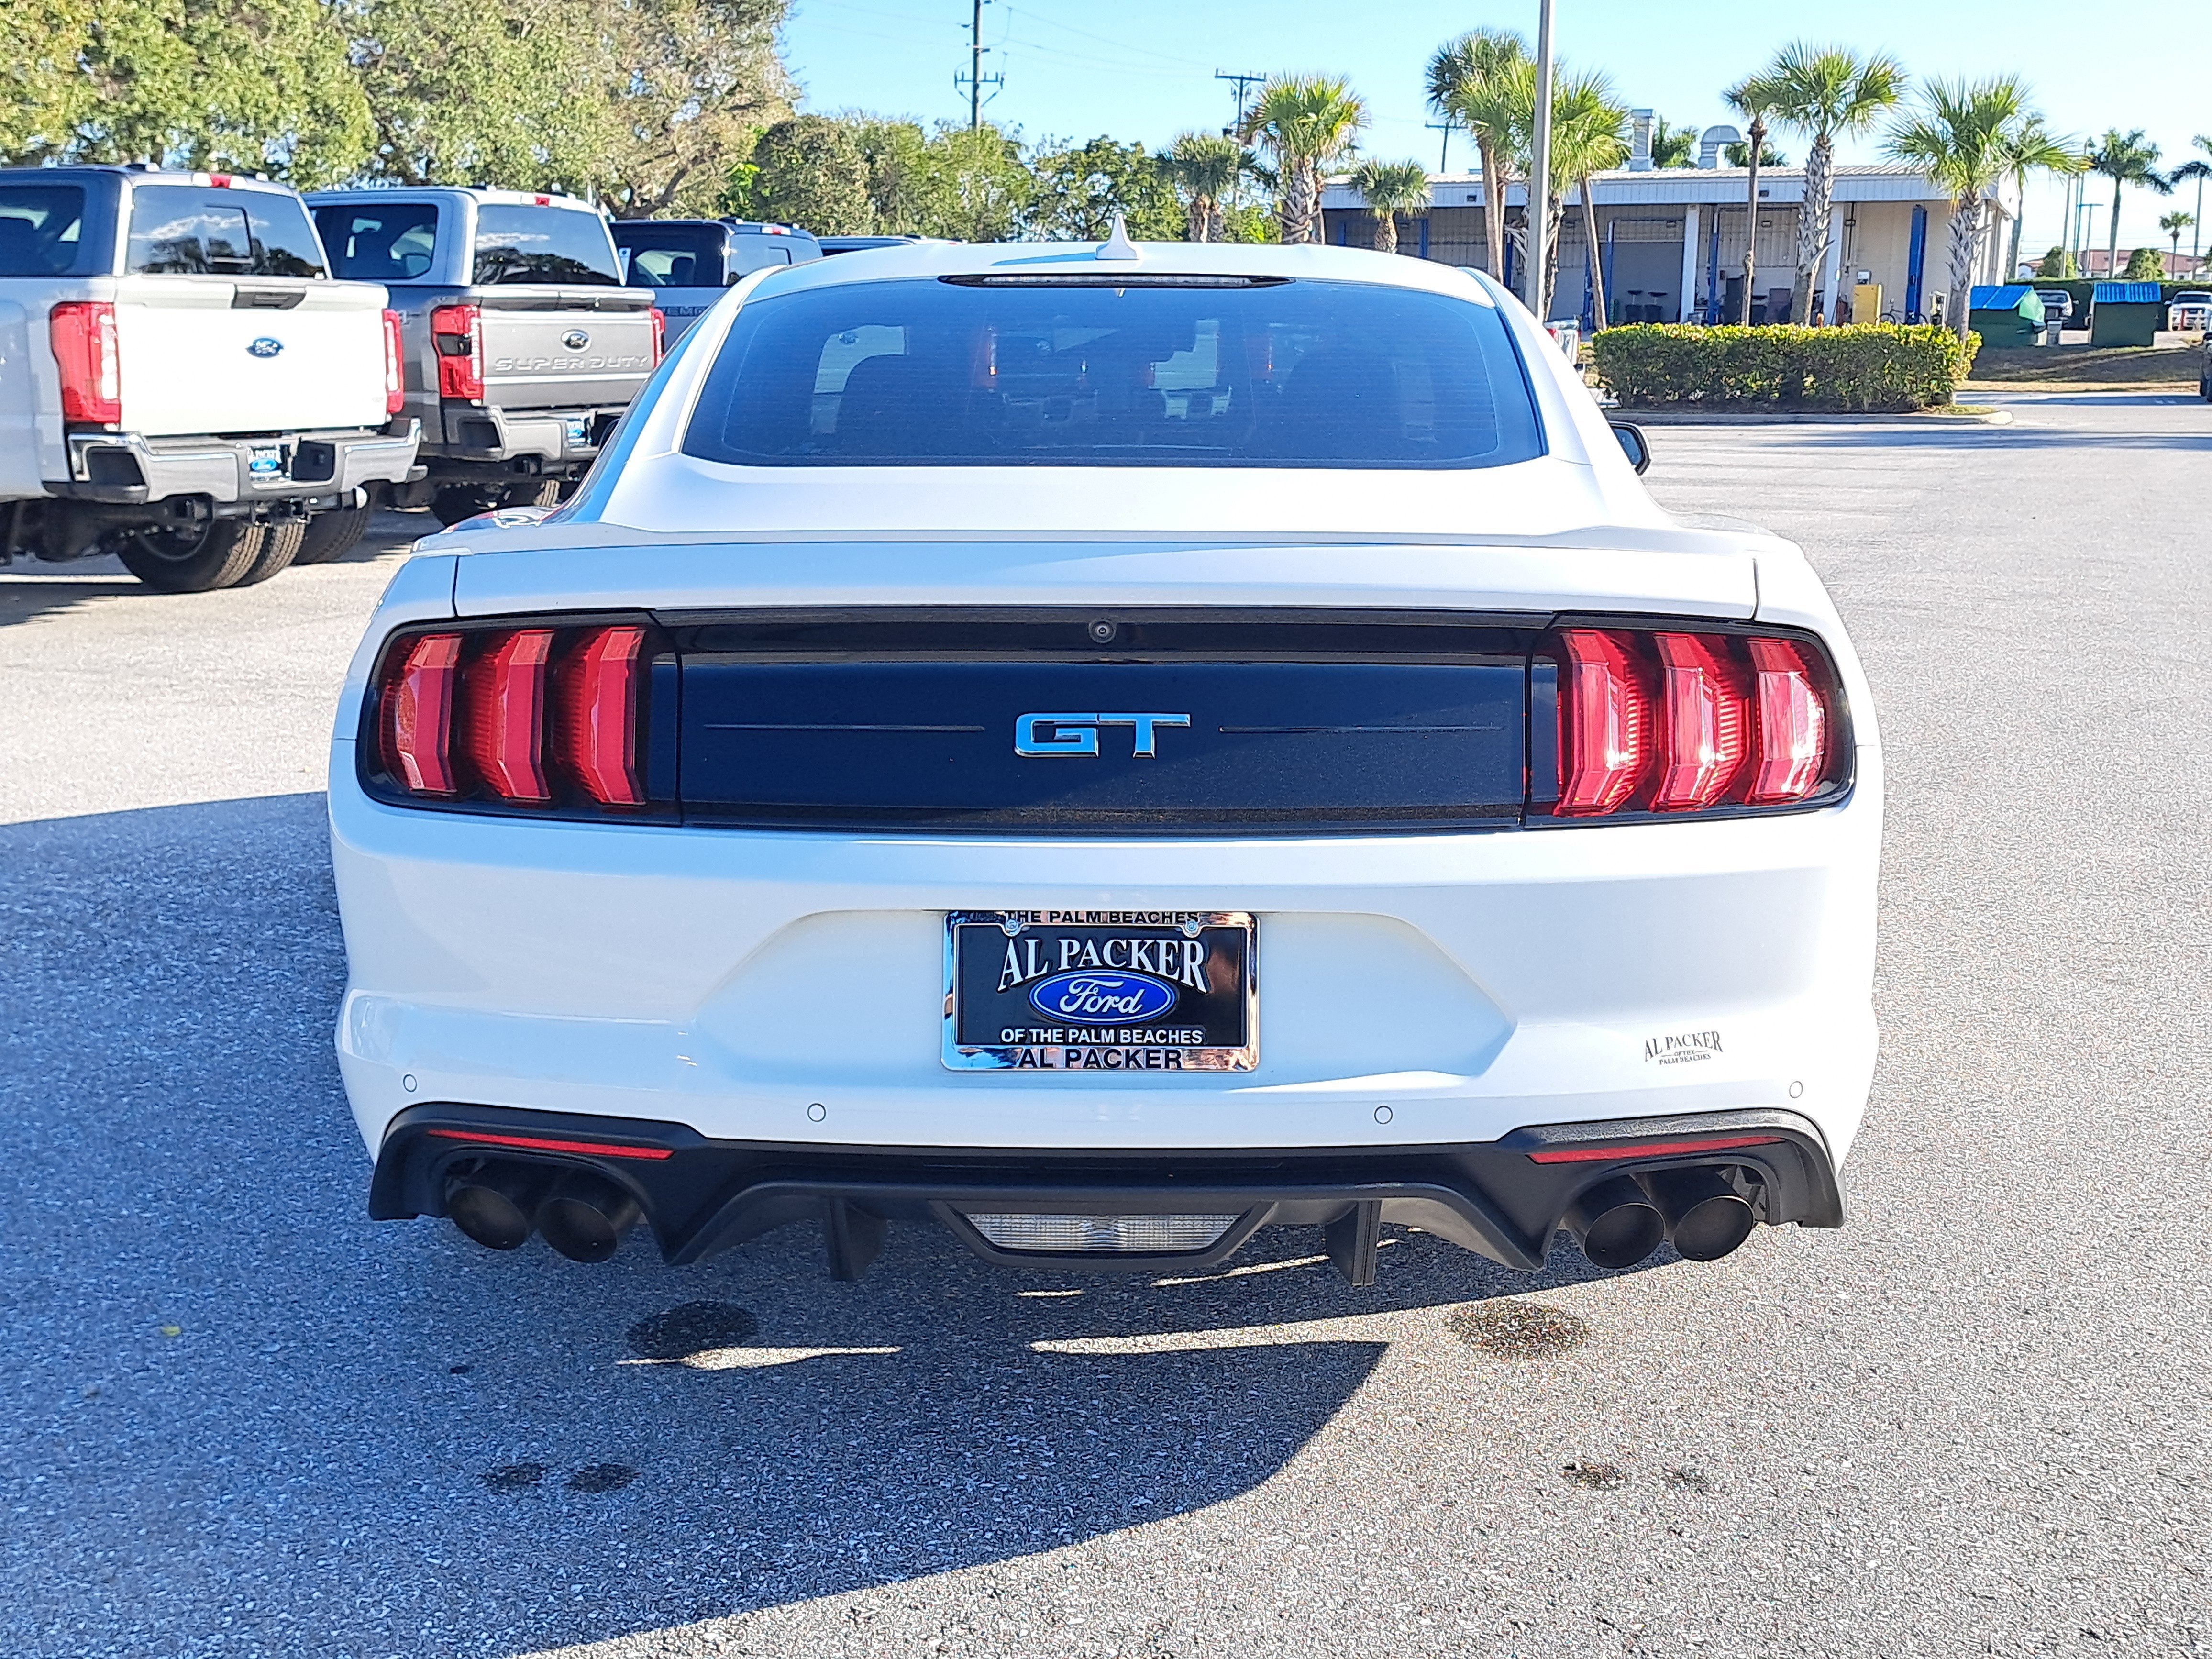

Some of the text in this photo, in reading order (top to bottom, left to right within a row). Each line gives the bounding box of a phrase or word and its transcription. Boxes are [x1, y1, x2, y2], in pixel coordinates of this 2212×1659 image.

[495, 356, 649, 371] SUPER DUTY
[1013, 712, 1191, 759] GT
[1005, 910, 1199, 923] THE PALM BEACHES
[997, 939, 1207, 994] AL PACKER
[1059, 978, 1146, 1015] Ford
[1001, 1029, 1204, 1044] OF THE PALM BEACHES
[1645, 1031, 1723, 1062] AL PACKER
[1018, 1048, 1183, 1069] AL PACKER
[1659, 1057, 1678, 1065] PALM
